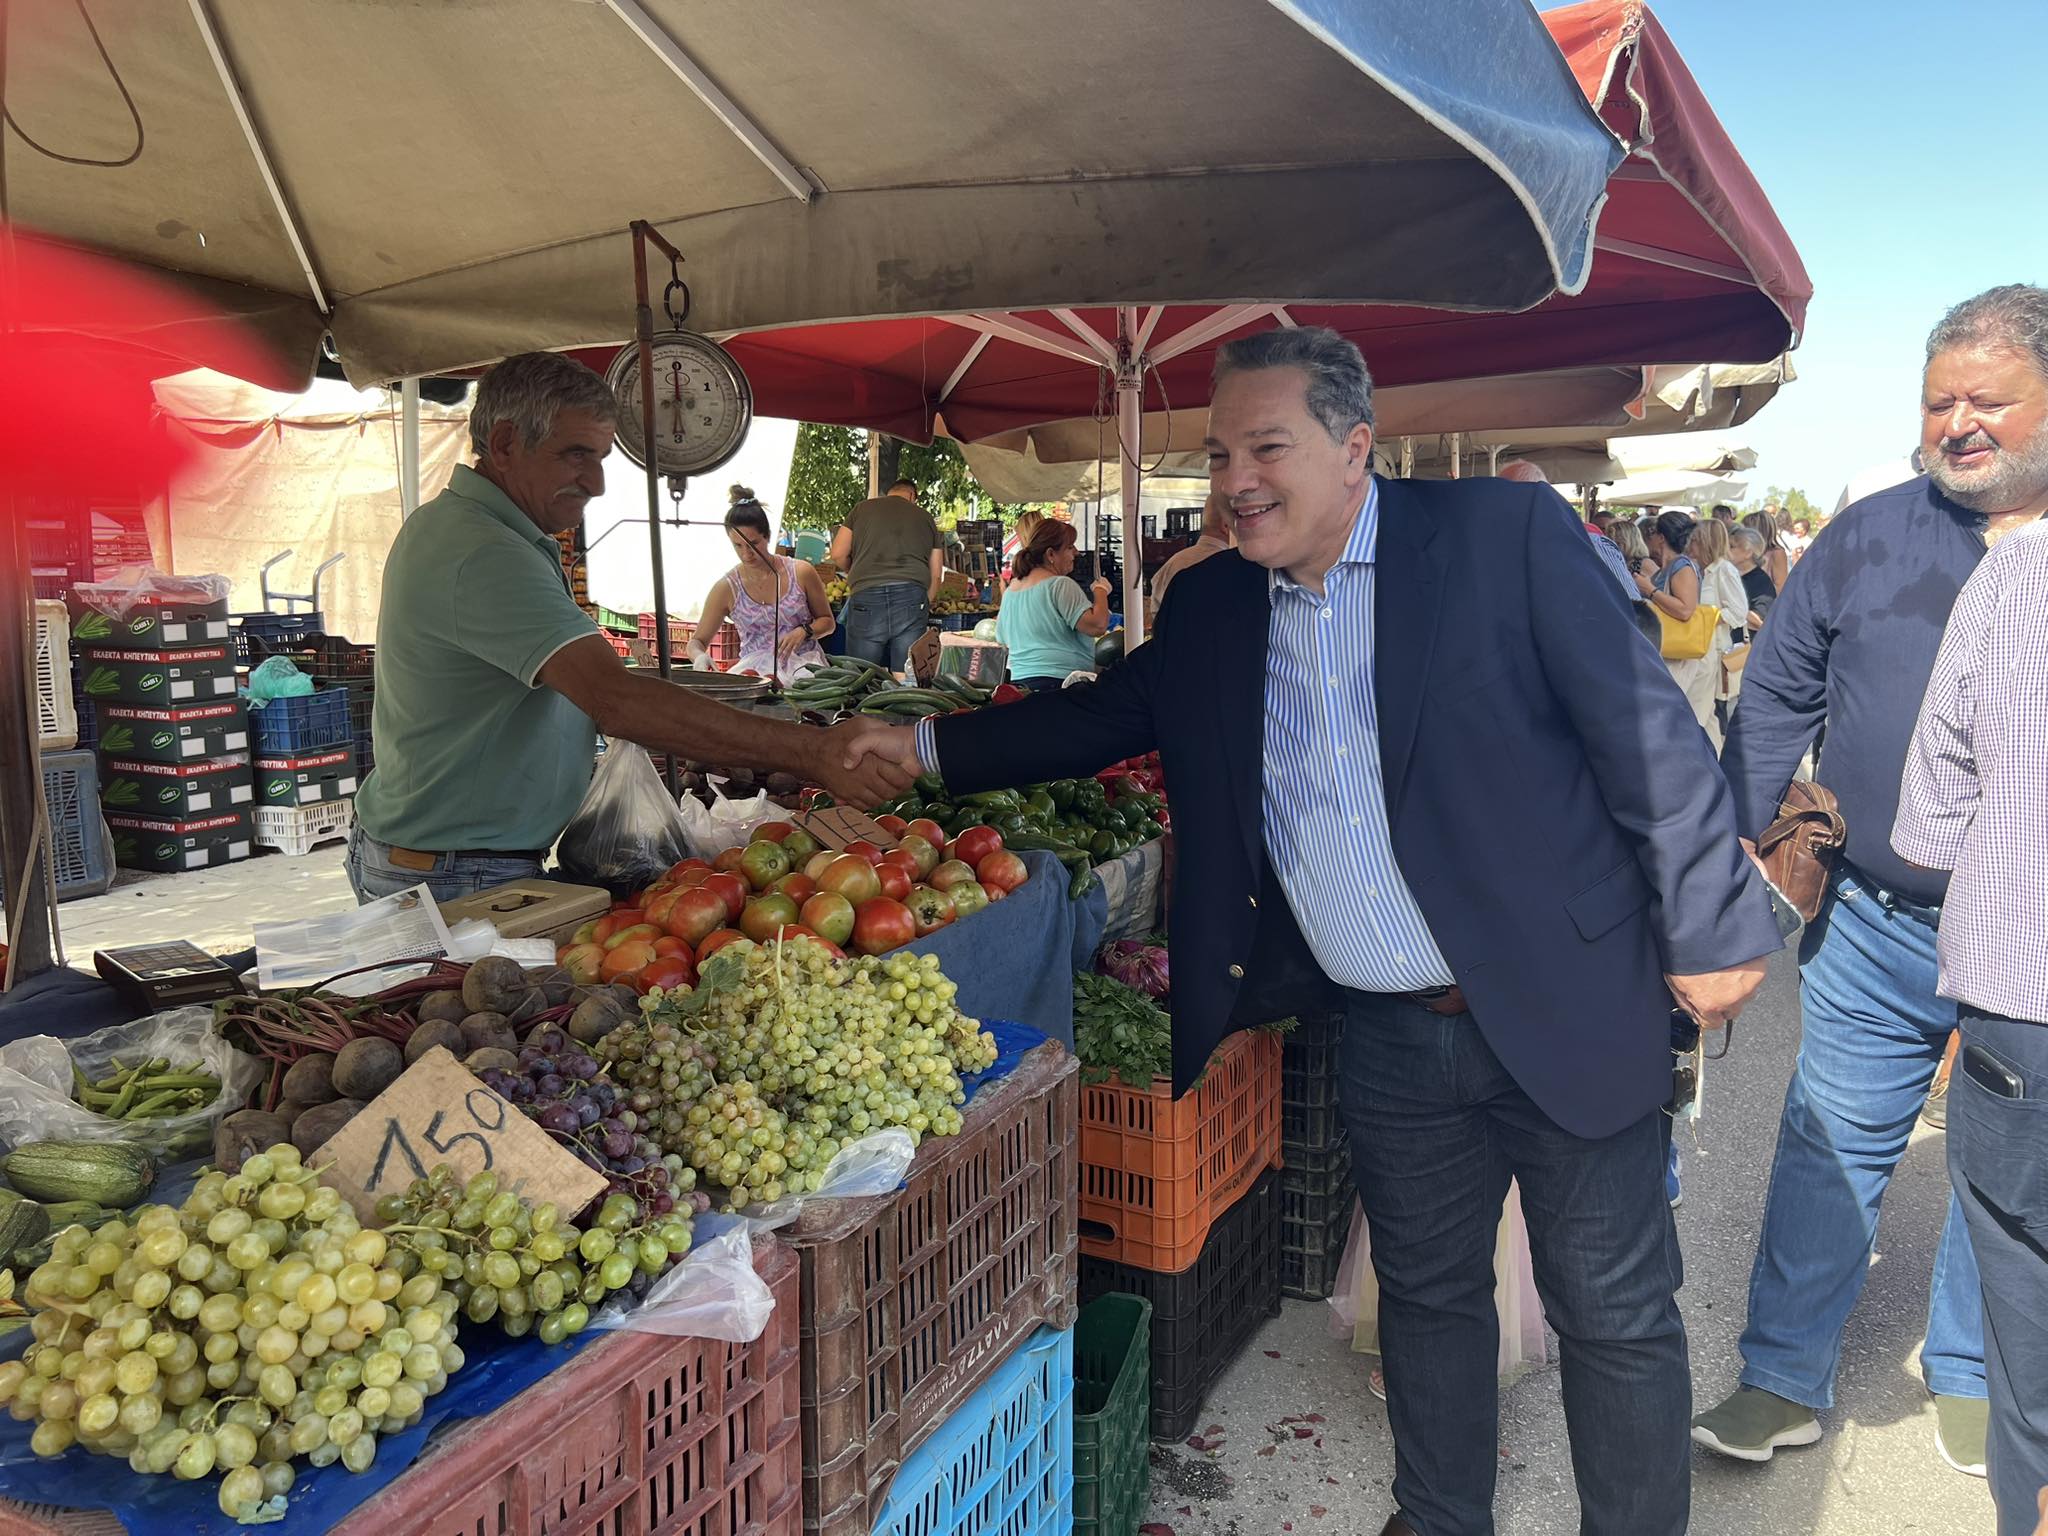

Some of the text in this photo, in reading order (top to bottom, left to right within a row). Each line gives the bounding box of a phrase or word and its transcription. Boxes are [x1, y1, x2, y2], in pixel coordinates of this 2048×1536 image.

[704, 382, 711, 392] 1
[703, 416, 713, 427] 2
[674, 434, 683, 444] 3
[93, 651, 161, 662] ΕΚΛΕΚΤΑ ΚΗΠΕΥΤΙΚΑ
[168, 650, 222, 661] ΕΚΛΕΚΤΑ ΚΗΠΕΥΤΙΚΑ
[968, 647, 981, 681] ΚΛΕΚΤΑ
[109, 708, 170, 721] ΕΚΛΕΚΤΑ ΚΗΠΕΥΤΙΚΑ
[113, 761, 178, 776] ΕΚΛΕΚΤΑ ΚΗΠΕΥΤΙΚΑ
[141, 820, 176, 832] ΚΗΠΕΥΤΙΚΑ
[948, 1311, 1011, 1388] ΑΛΑΤΖΑΣ
